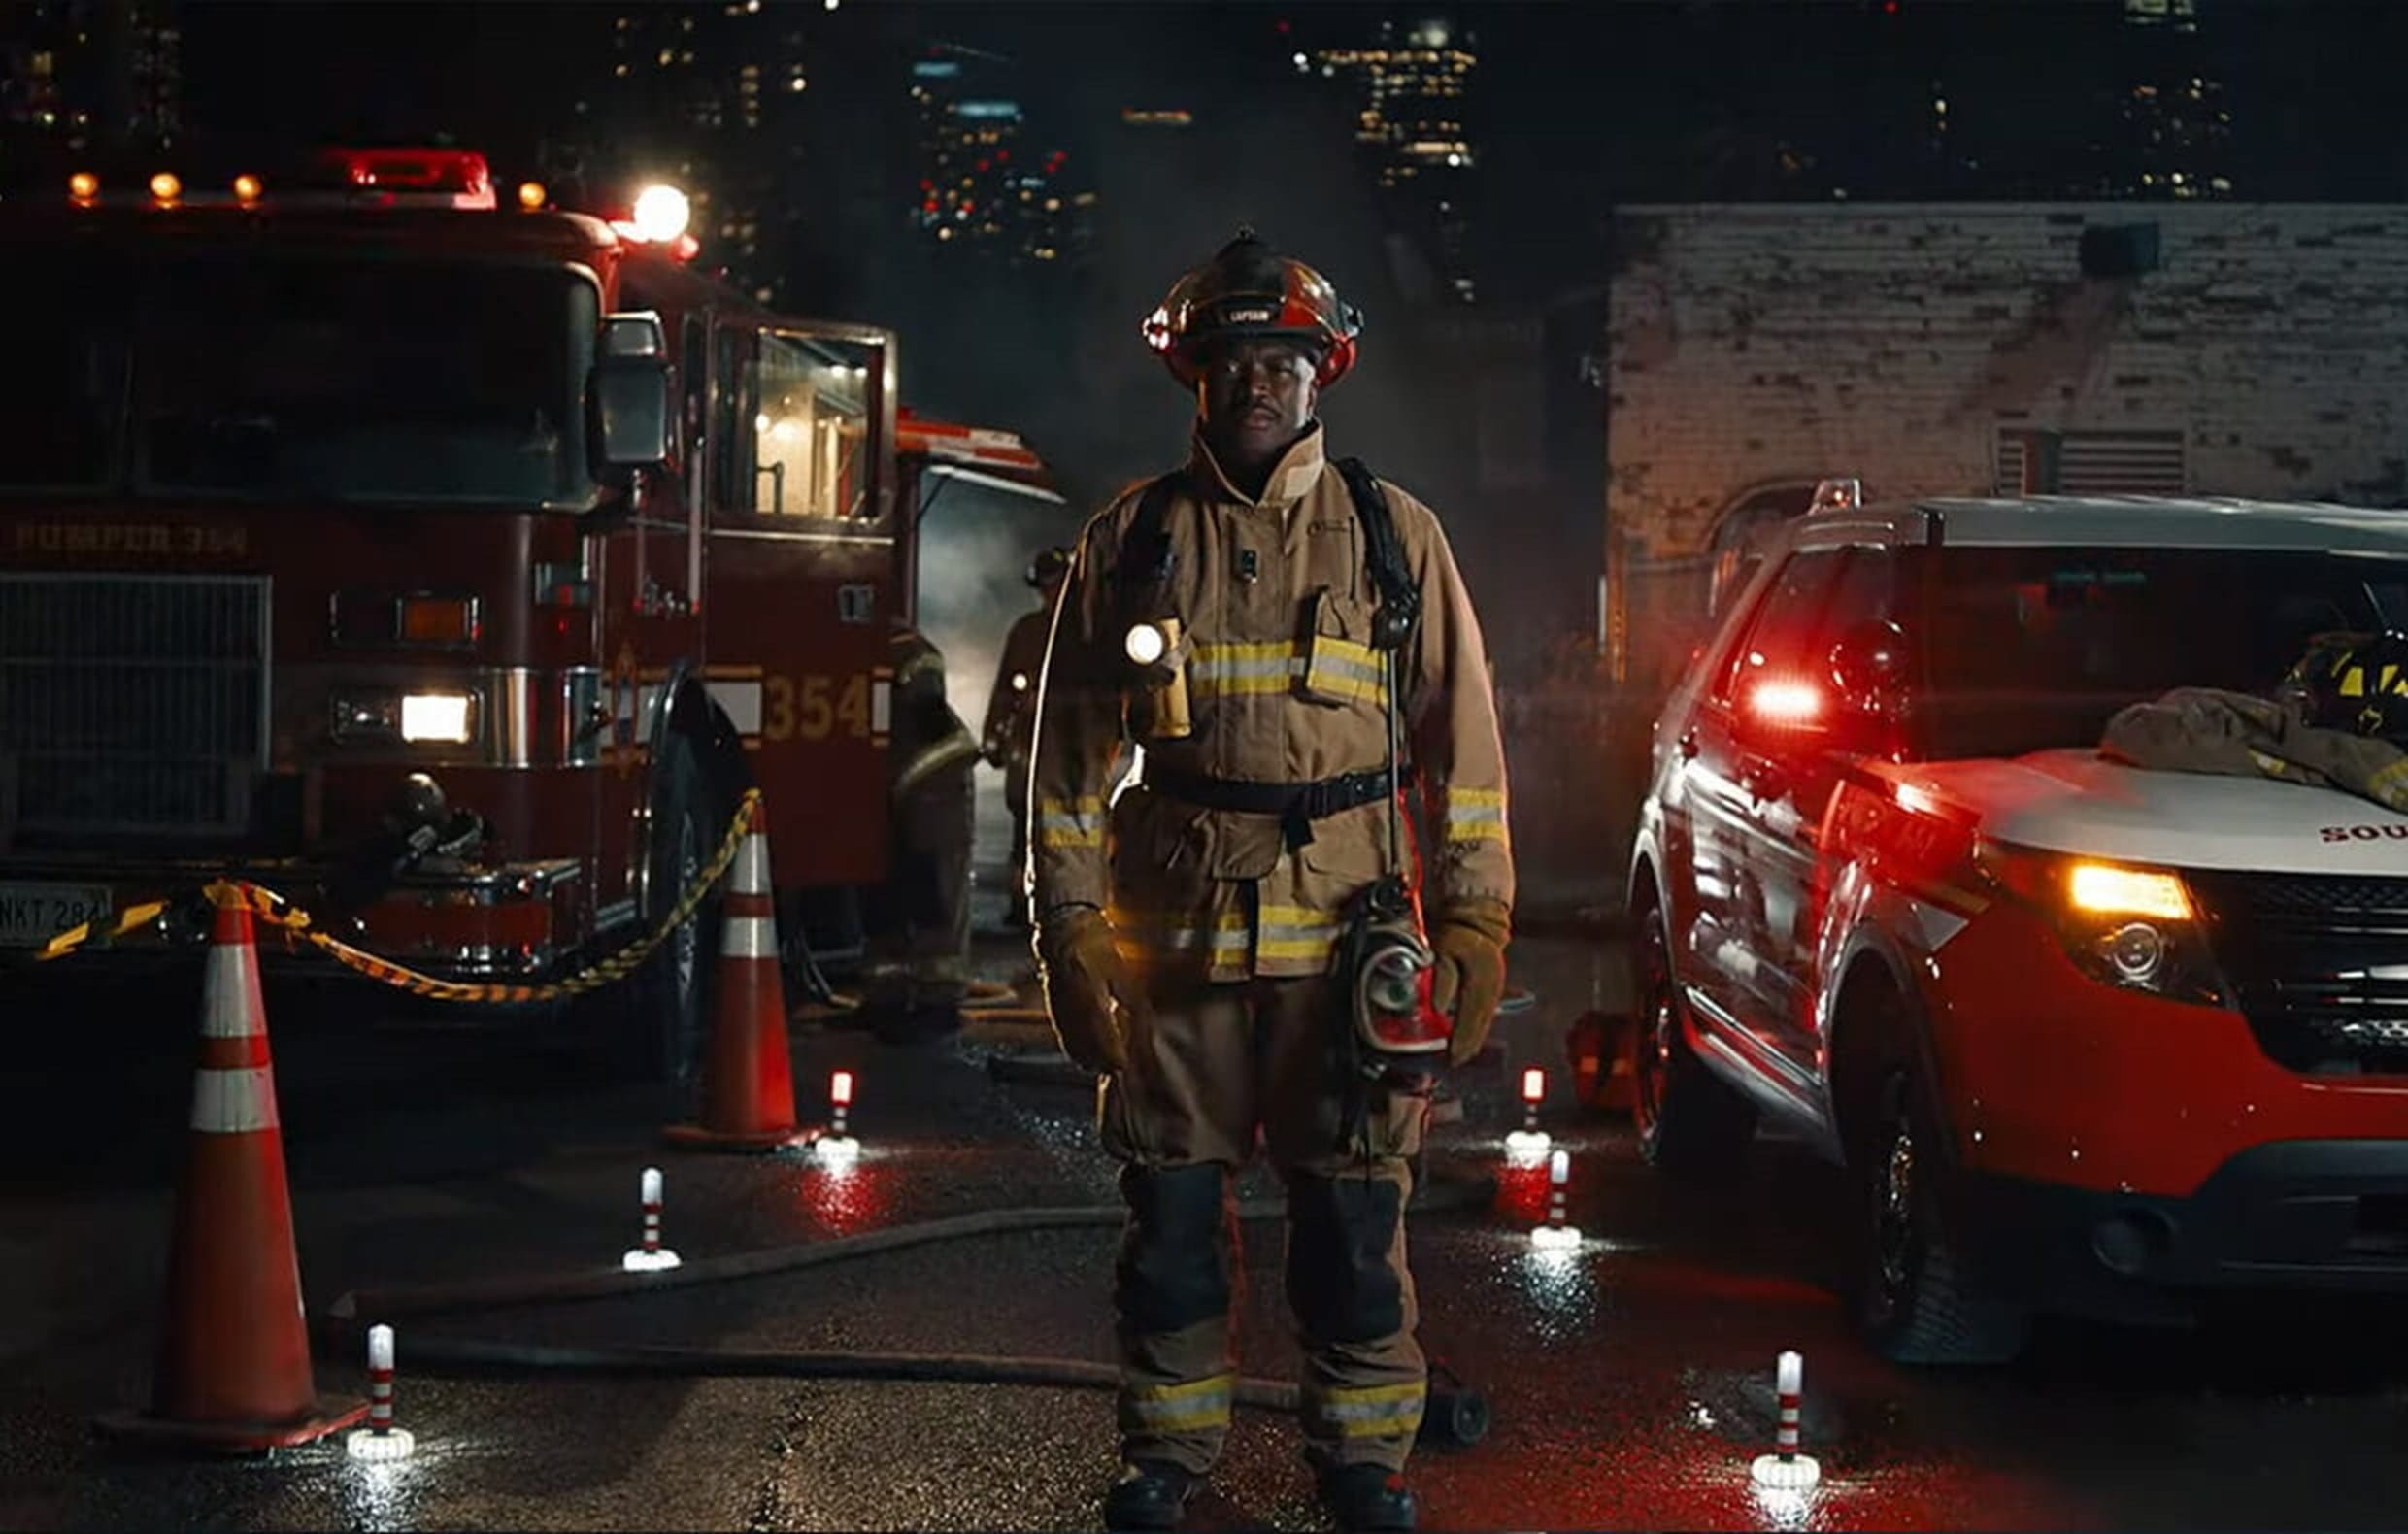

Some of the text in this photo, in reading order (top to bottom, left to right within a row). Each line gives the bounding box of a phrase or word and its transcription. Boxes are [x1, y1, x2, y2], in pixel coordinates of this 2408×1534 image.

[15, 523, 172, 555] PUMPER
[764, 673, 870, 742] 354
[2319, 824, 2408, 843] SOU
